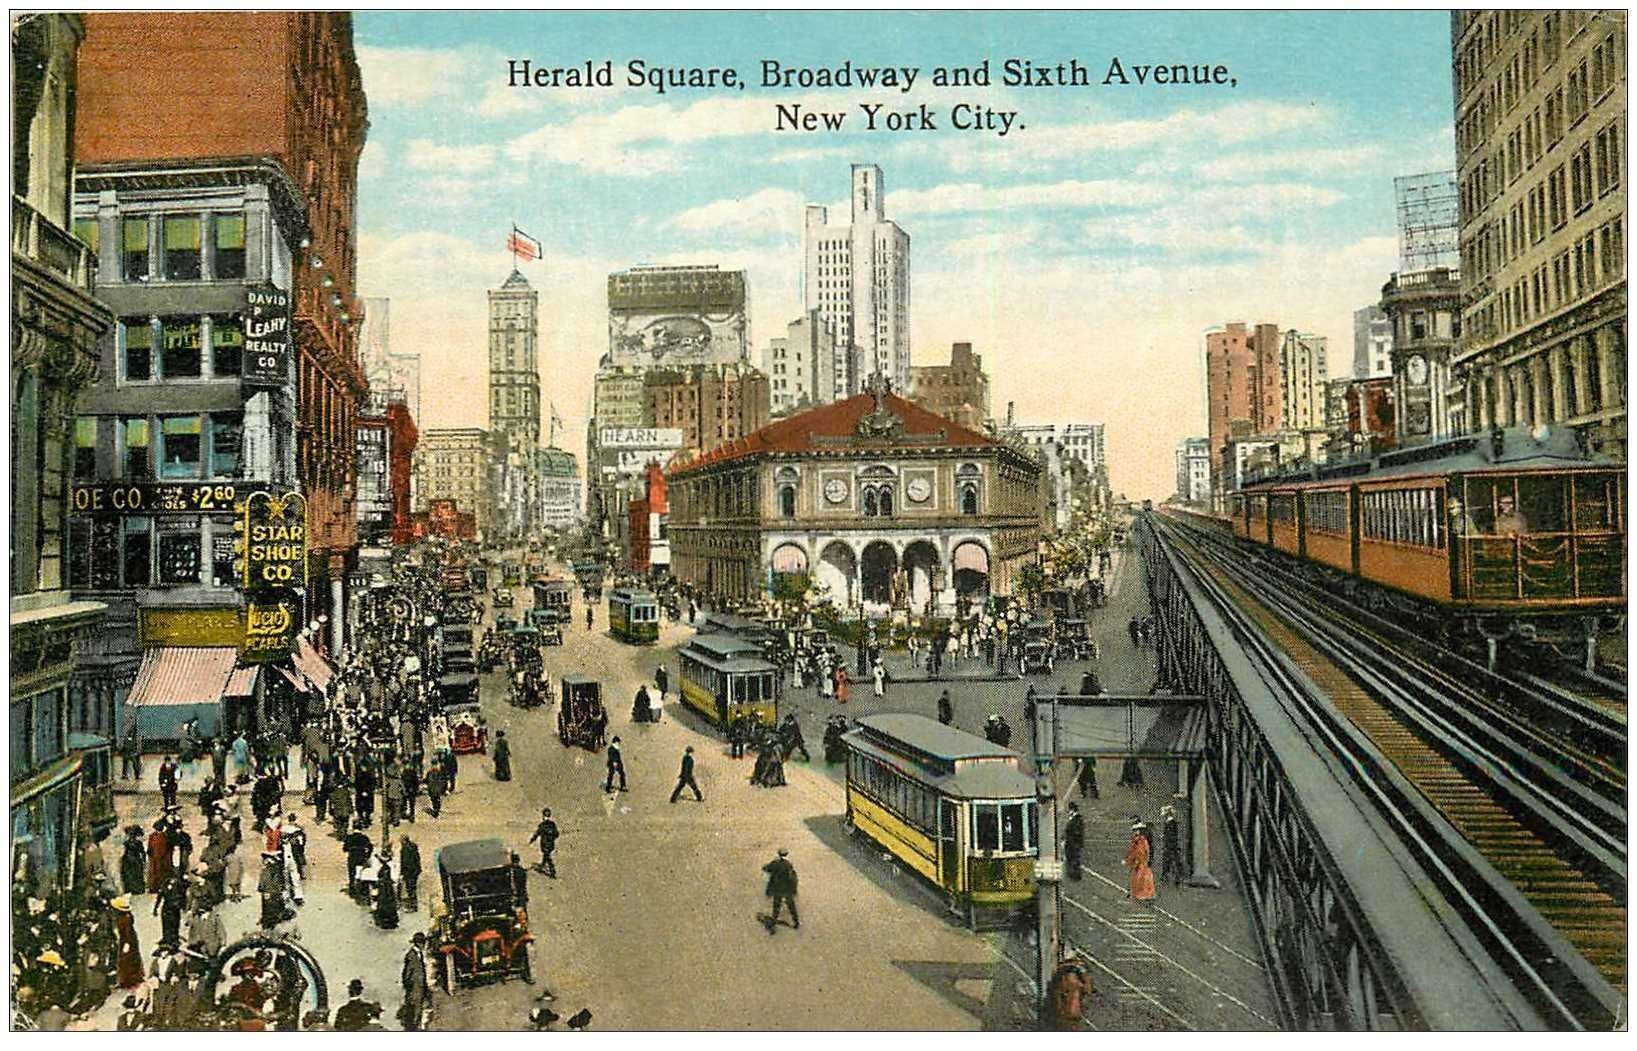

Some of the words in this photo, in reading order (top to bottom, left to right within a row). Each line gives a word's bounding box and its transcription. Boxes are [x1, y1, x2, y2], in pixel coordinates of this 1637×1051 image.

[248, 292, 286, 306] DAVID
[245, 340, 287, 354] REALTY
[604, 430, 657, 442] HEARN
[252, 525, 304, 541] STAR
[251, 545, 303, 561] SHOE
